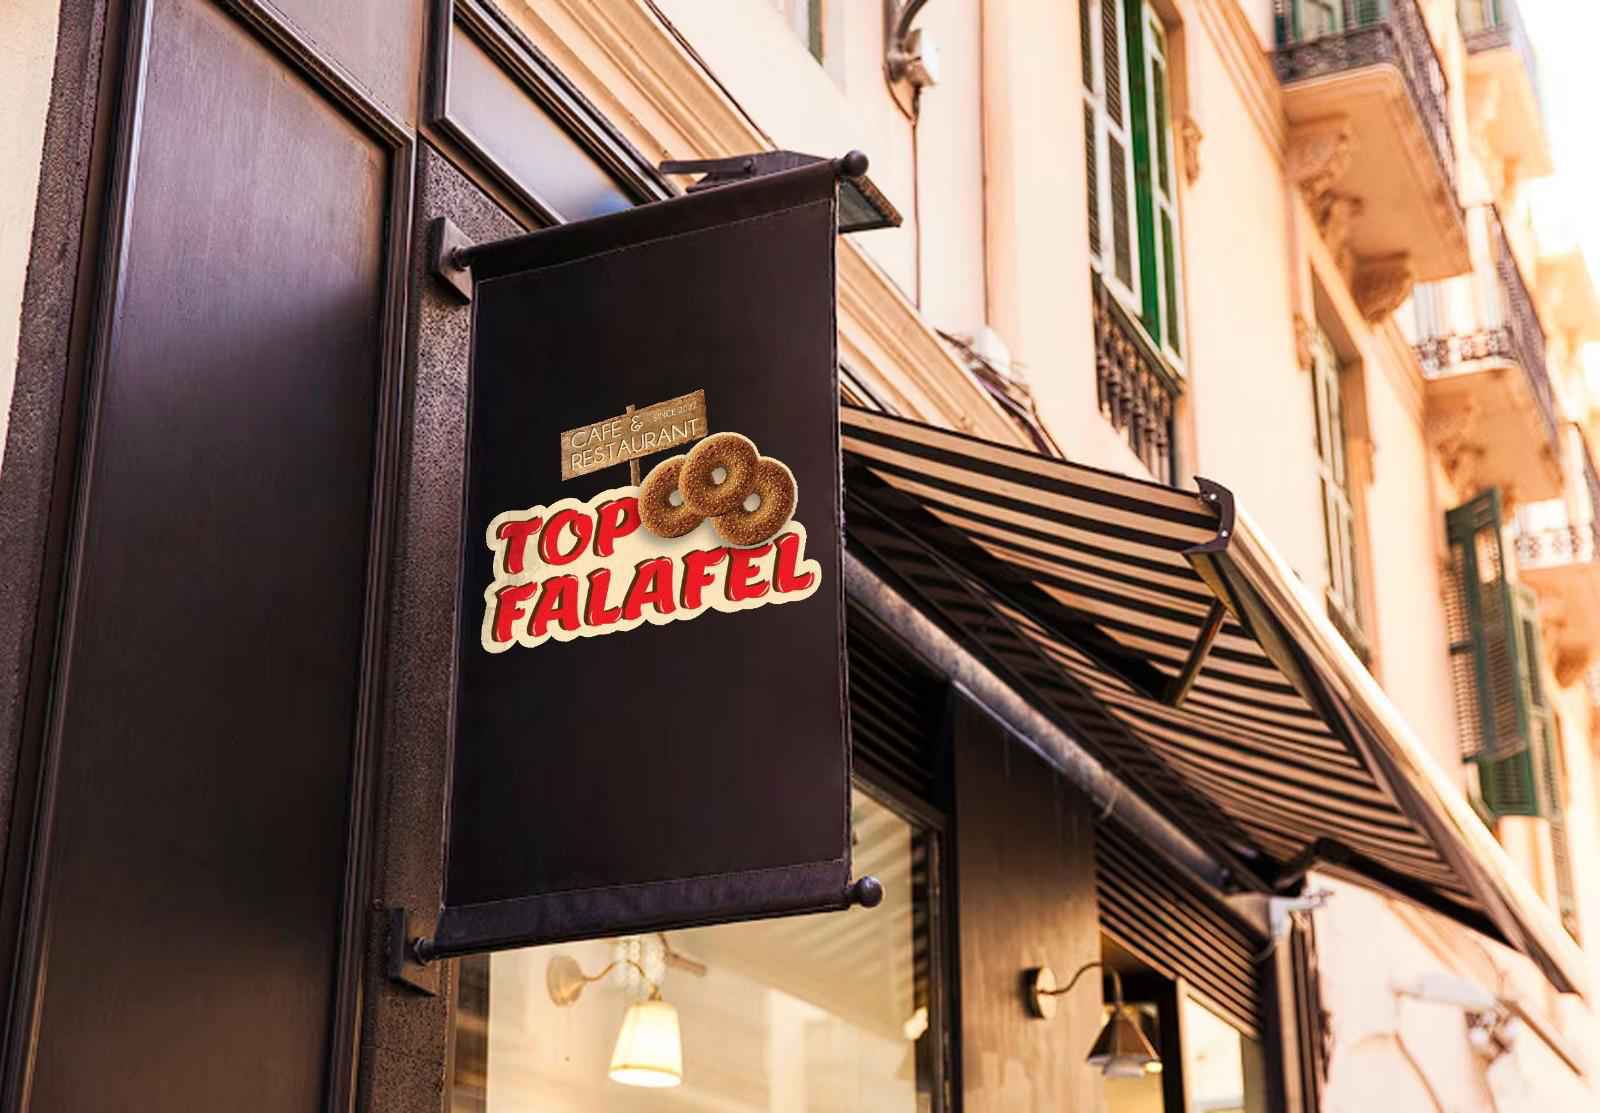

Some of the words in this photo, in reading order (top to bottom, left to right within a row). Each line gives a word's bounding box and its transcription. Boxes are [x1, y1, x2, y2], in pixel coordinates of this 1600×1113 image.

[571, 420, 622, 448] CAFE
[630, 415, 643, 432] &
[571, 418, 700, 470] RESTAURANT
[496, 496, 641, 575] TOP
[491, 532, 815, 642] FALAFEL
